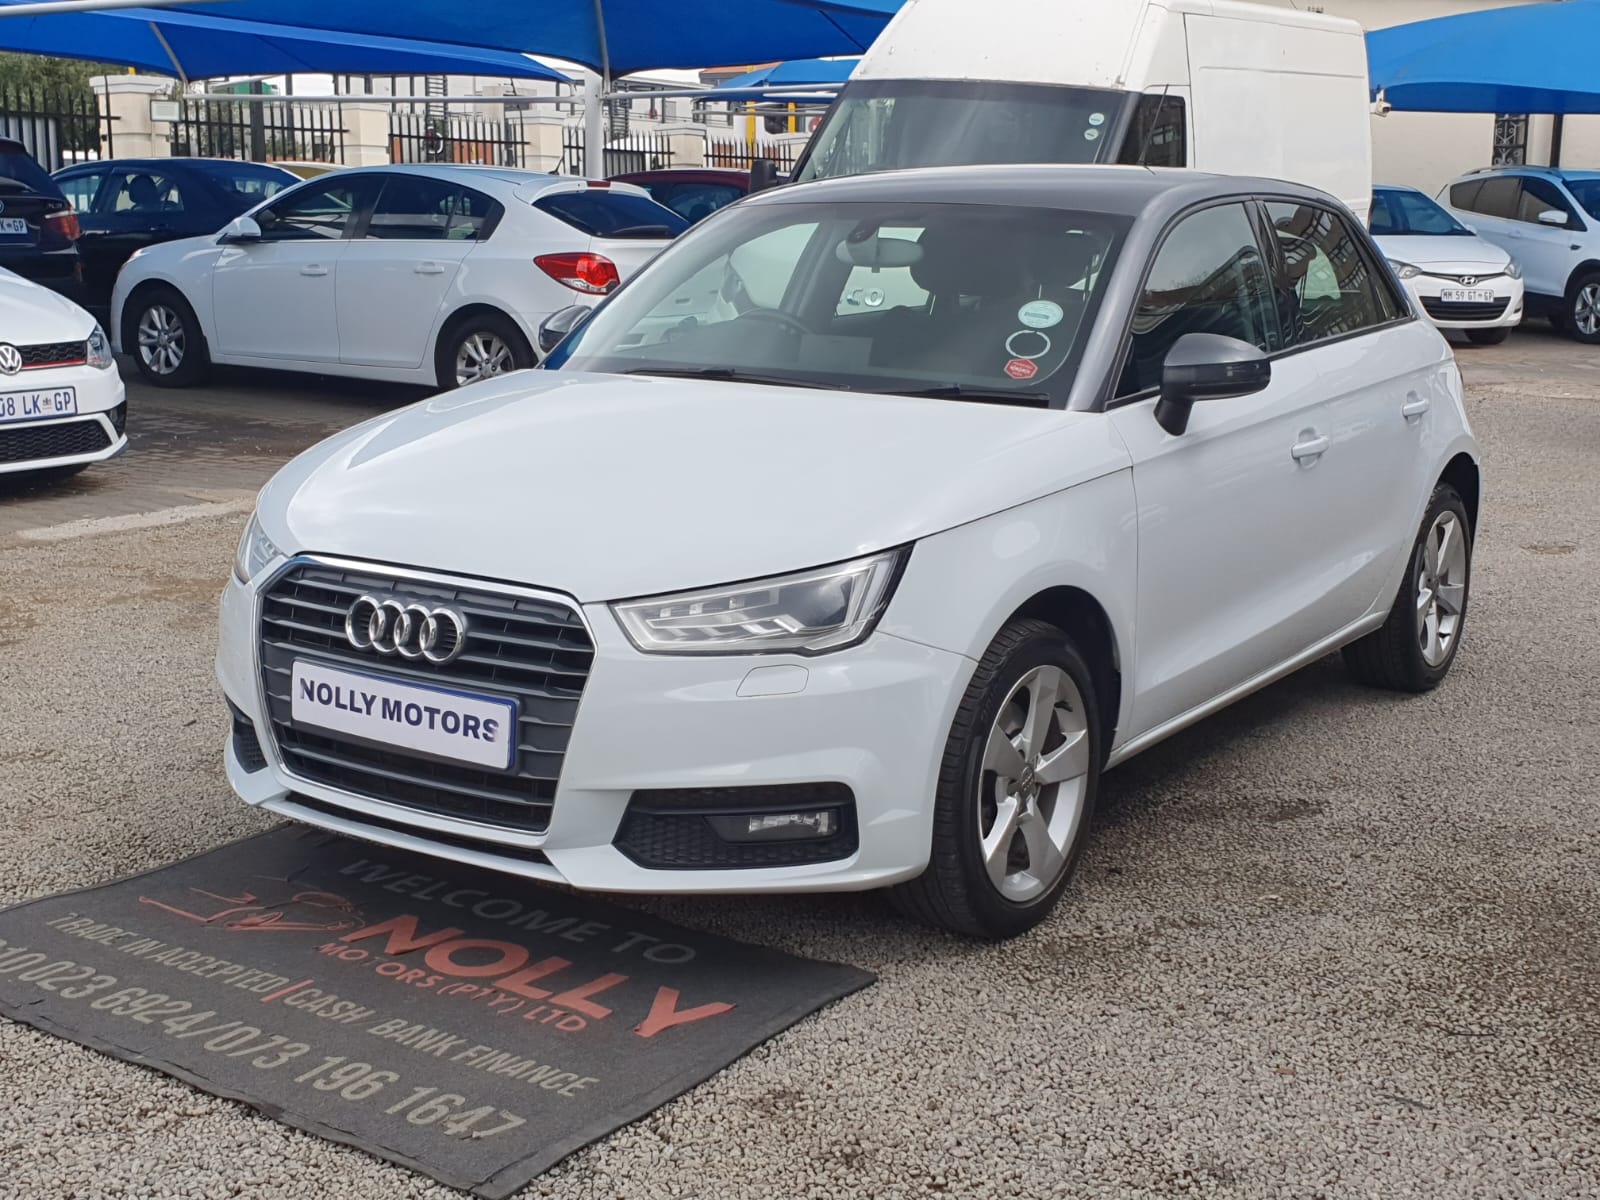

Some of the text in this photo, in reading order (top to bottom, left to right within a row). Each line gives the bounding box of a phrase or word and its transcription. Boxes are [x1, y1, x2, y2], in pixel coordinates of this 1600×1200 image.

[12, 218, 24, 232] GP
[23, 394, 42, 415] LK
[54, 391, 71, 411] GP
[299, 677, 500, 742] NOLLY MOTORS
[339, 859, 696, 964] WELCOME TO
[46, 912, 138, 945] TRADE
[118, 938, 167, 956] IN
[449, 1045, 600, 1097] FINANCE
[339, 914, 737, 1039] NOLLY
[436, 982, 526, 1016] (PTY)
[522, 1005, 588, 1031] LTD
[294, 1056, 400, 1100] 196
[384, 1086, 527, 1139] 1647
